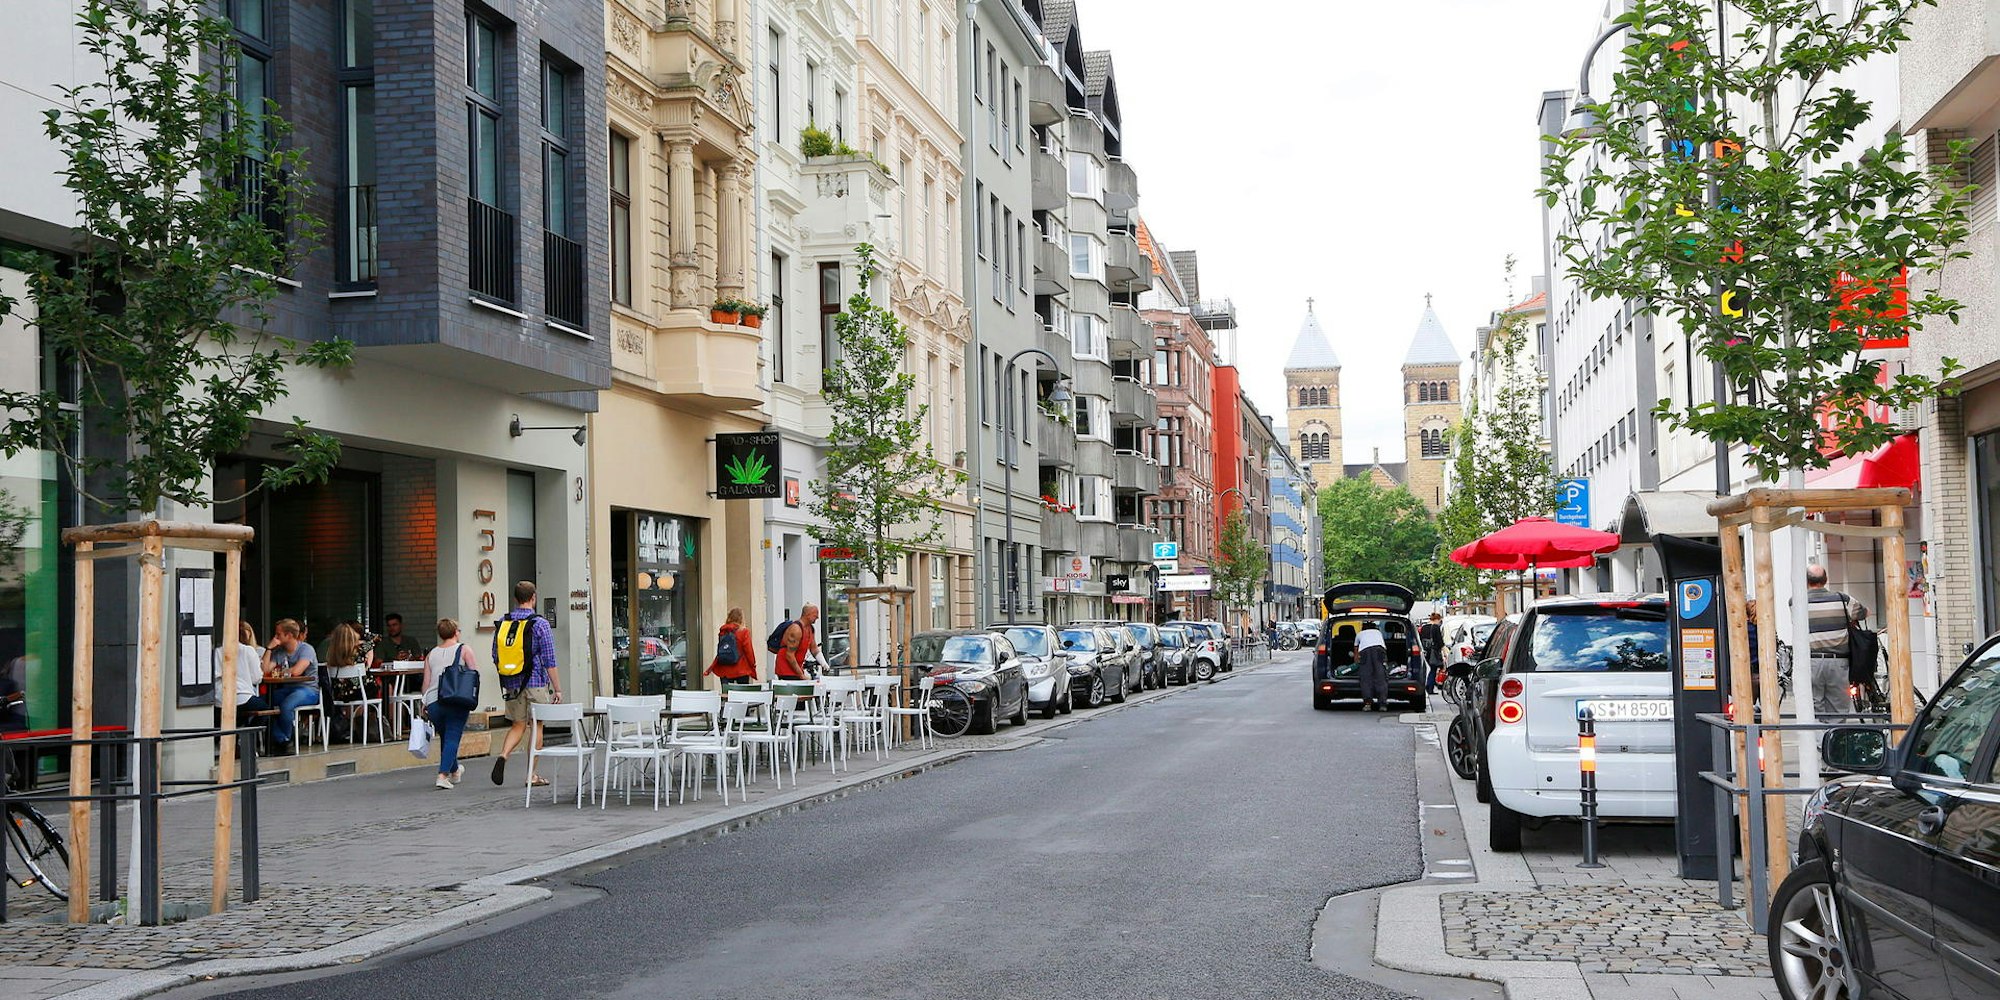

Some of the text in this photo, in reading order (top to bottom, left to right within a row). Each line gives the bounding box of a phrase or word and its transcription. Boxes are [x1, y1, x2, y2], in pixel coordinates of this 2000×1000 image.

[575, 476, 583, 502] 3
[719, 484, 776, 495] GALACTIC
[1112, 578, 1127, 587] sky
